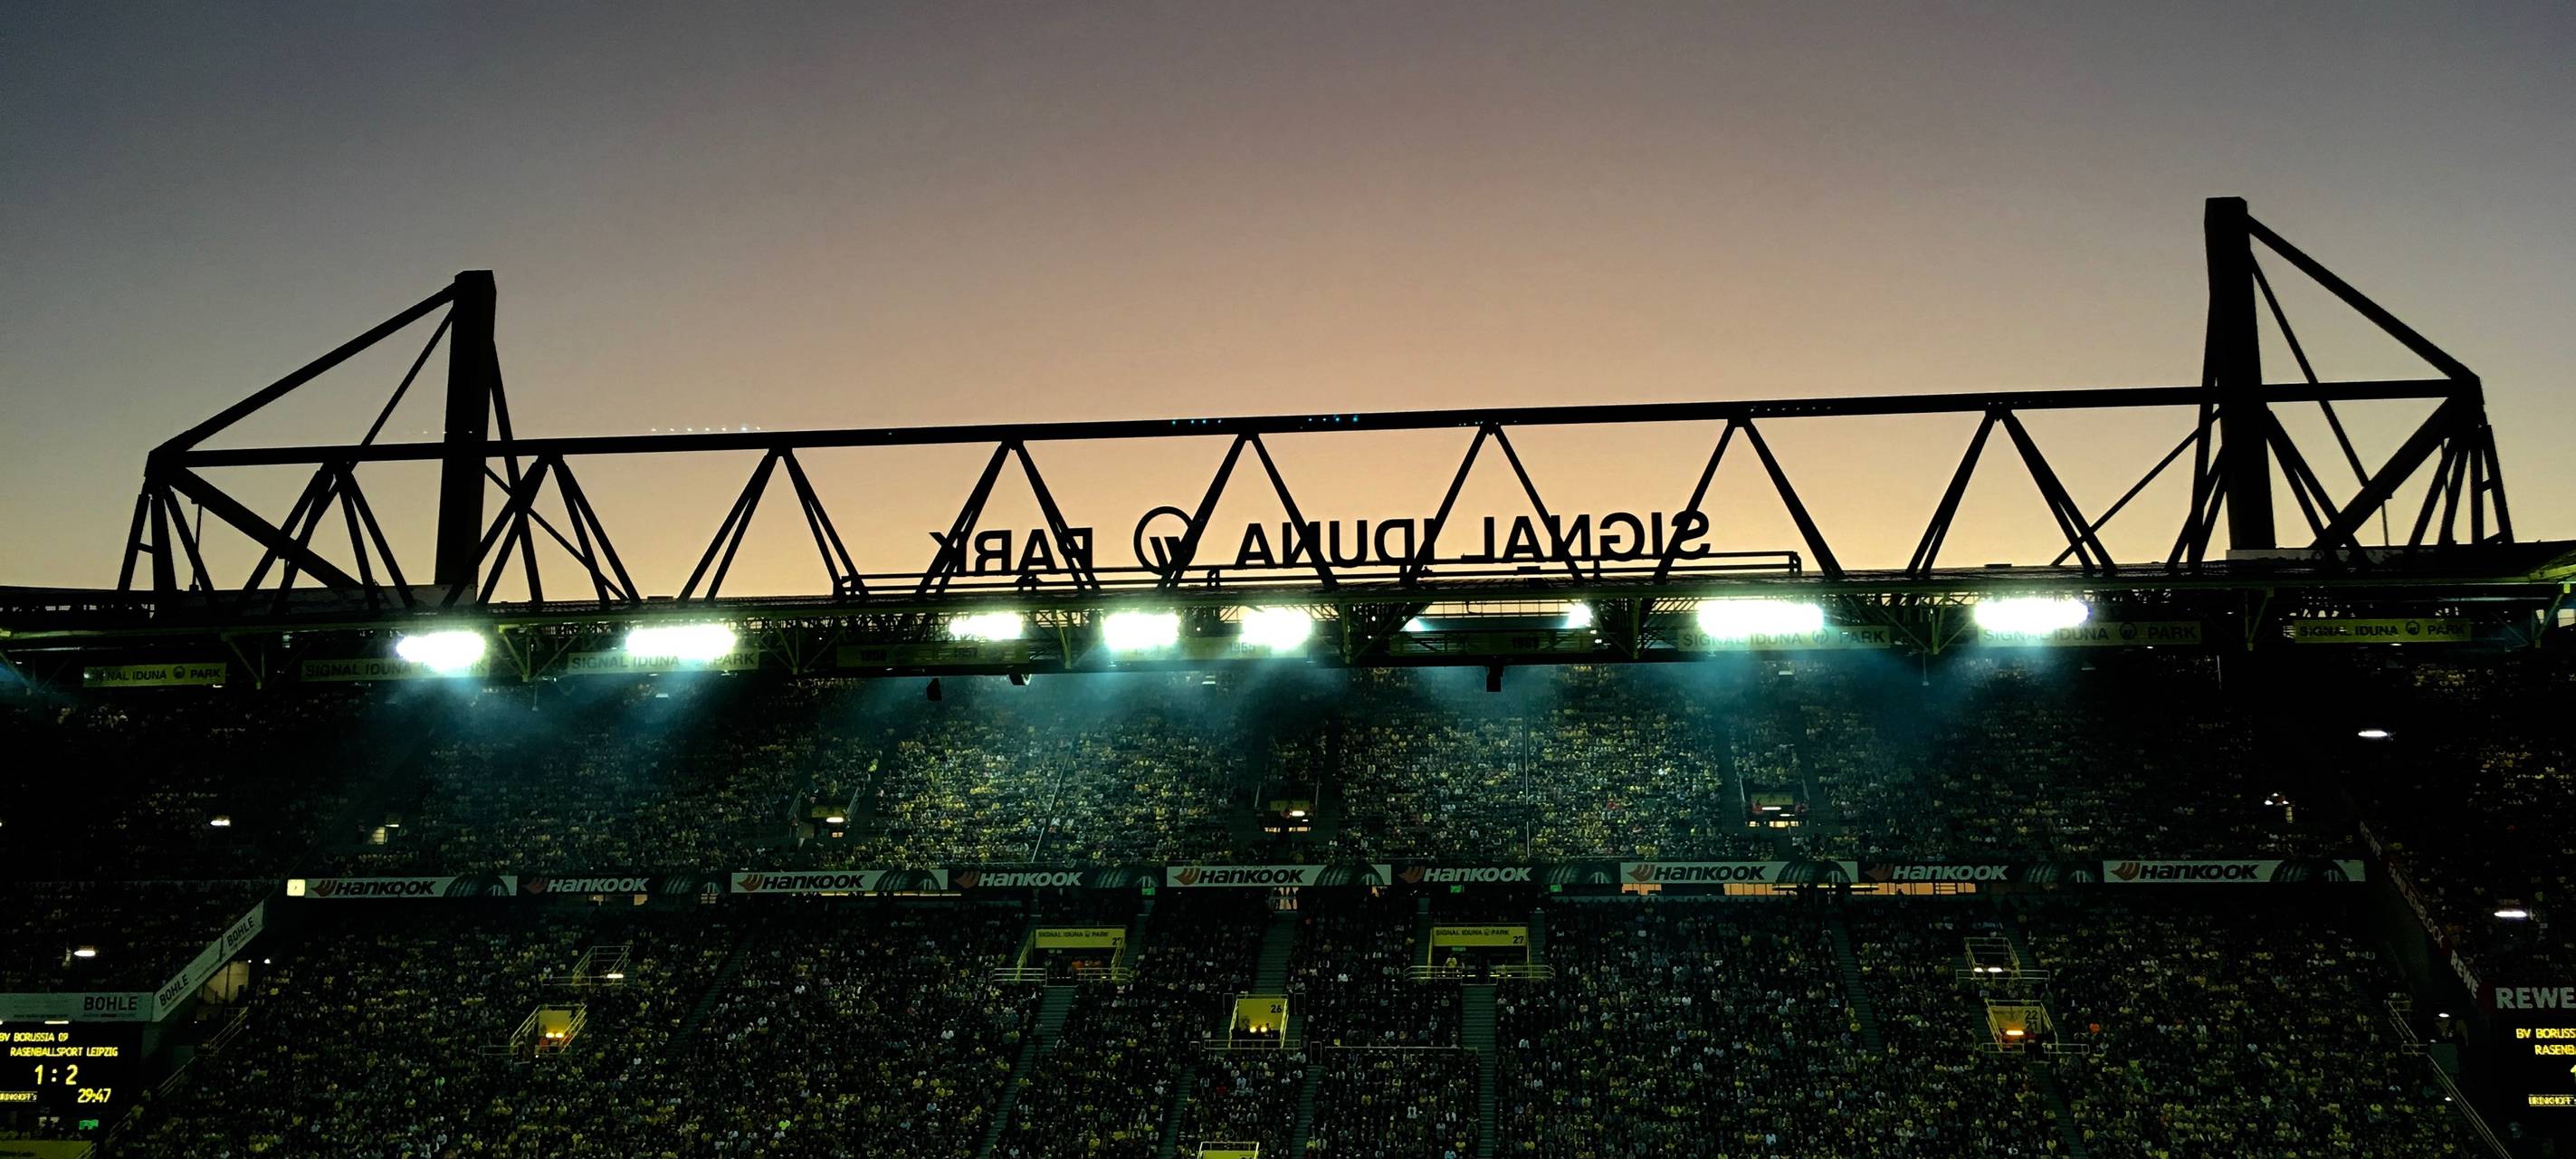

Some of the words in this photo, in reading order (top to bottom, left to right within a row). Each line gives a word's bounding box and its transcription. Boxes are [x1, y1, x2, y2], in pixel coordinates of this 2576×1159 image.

[1839, 630, 1885, 644] PARK
[2055, 627, 2109, 640] IDUNA
[2148, 626, 2197, 639] PARK
[2355, 626, 2398, 636] IDUNA
[2428, 625, 2465, 635] PARK
[305, 664, 360, 676] SIGNAL
[366, 662, 413, 675] IDUNA
[572, 656, 628, 669] SIGNAL
[633, 655, 681, 667] IDUNA
[132, 670, 167, 680] IDUNA
[190, 668, 221, 678] PARK
[227, 916, 254, 947] BOHLE
[1512, 935, 1524, 943] 27
[159, 973, 189, 1006] BOHLE
[84, 996, 138, 1011] BOHLE
[2495, 987, 2576, 1009] REWE
[1270, 1004, 1283, 1013] 26
[2025, 1010, 2038, 1020] 22
[14, 1032, 54, 1042] BORUSSIA
[58, 1032, 69, 1042] 09
[2515, 1028, 2531, 1039] BV
[2535, 1028, 2576, 1039] BORUSS
[10, 1047, 83, 1057] RASENBALLSPORT
[86, 1047, 119, 1057] LEIPZIG
[2534, 1045, 2576, 1056] RASENB
[34, 1064, 43, 1085] 1
[65, 1064, 79, 1085] 2
[77, 1087, 111, 1103] 29:47
